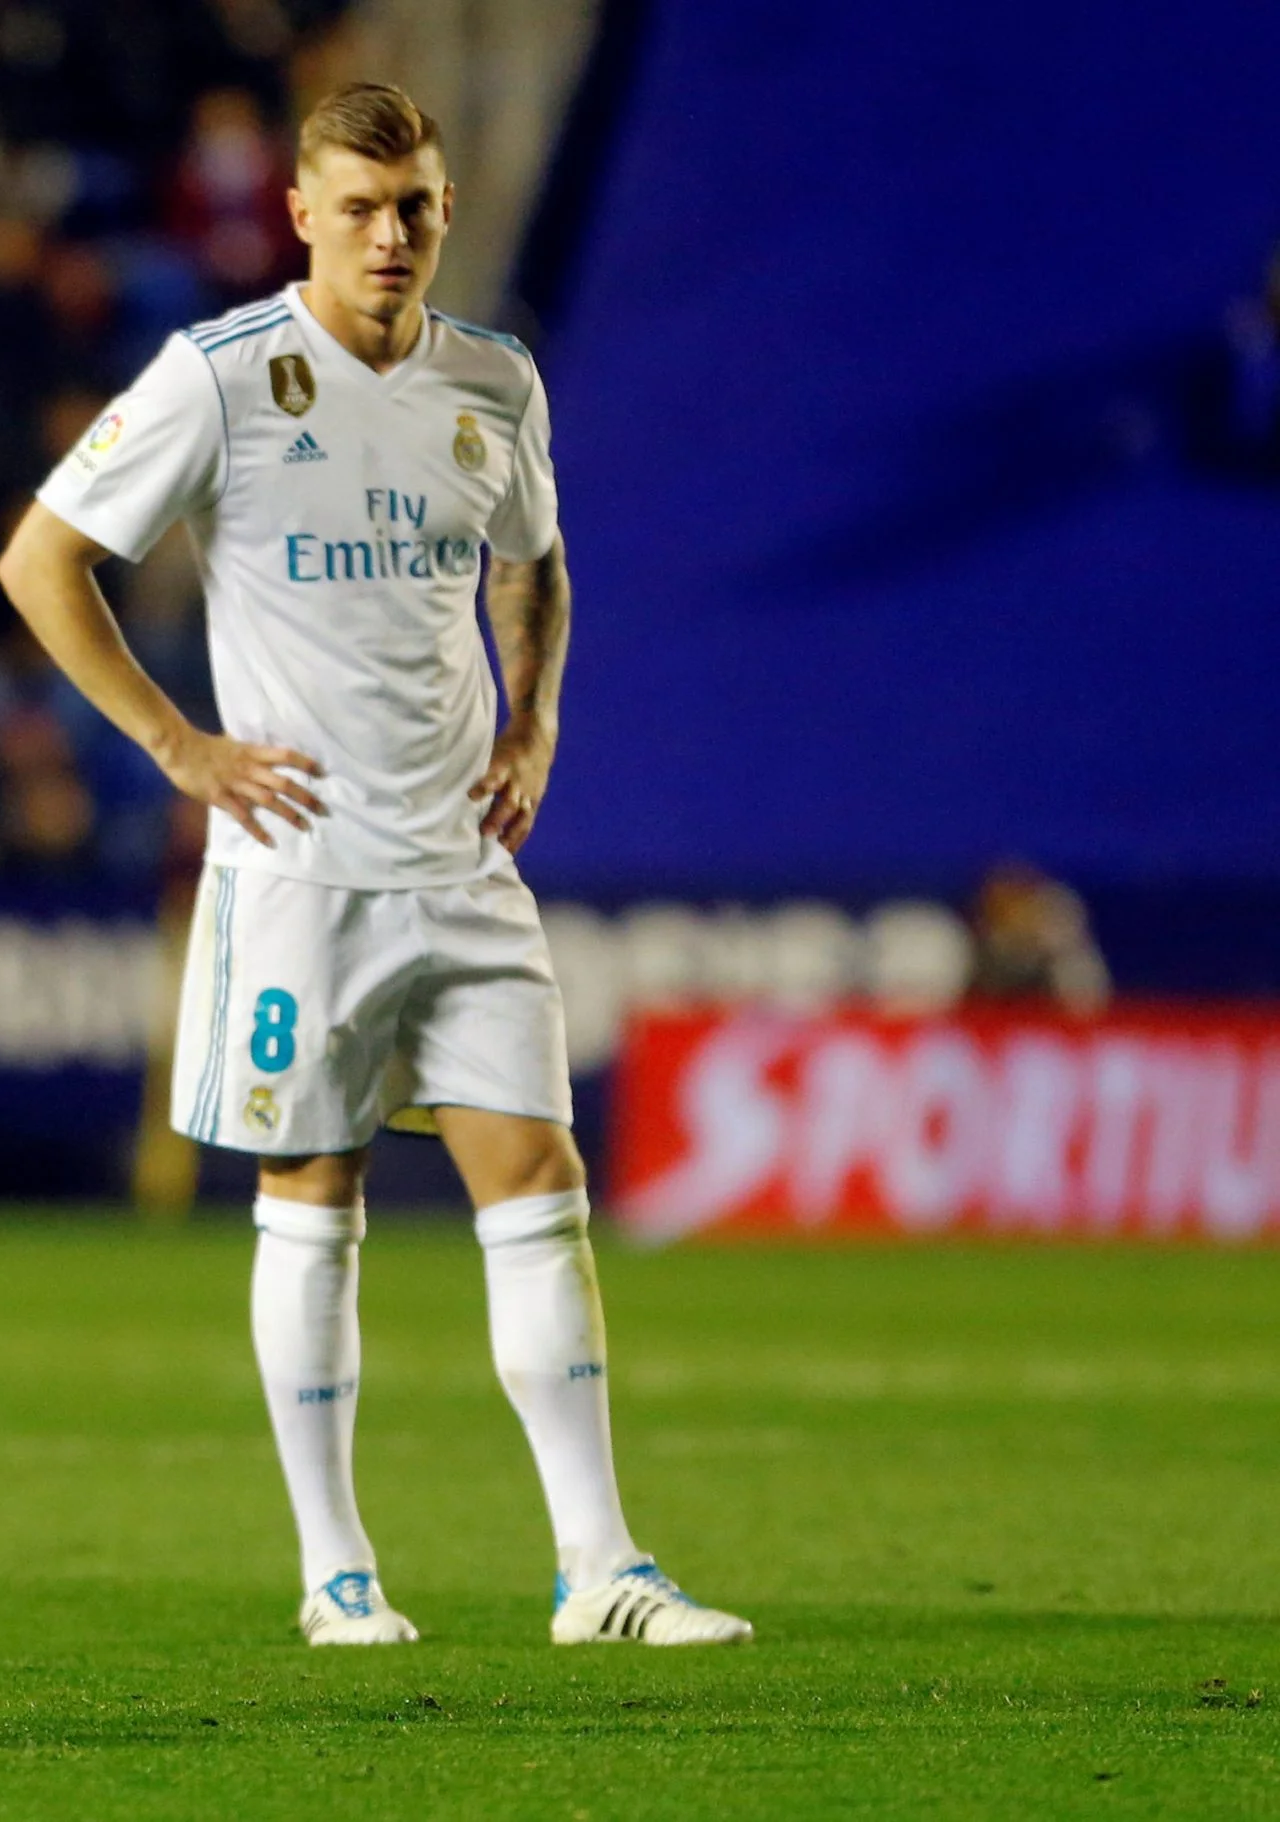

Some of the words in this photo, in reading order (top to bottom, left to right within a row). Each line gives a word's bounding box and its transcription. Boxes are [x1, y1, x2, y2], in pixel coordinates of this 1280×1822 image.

[282, 448, 328, 463] adidas
[366, 488, 426, 528] Fly
[250, 988, 298, 1074] 8
